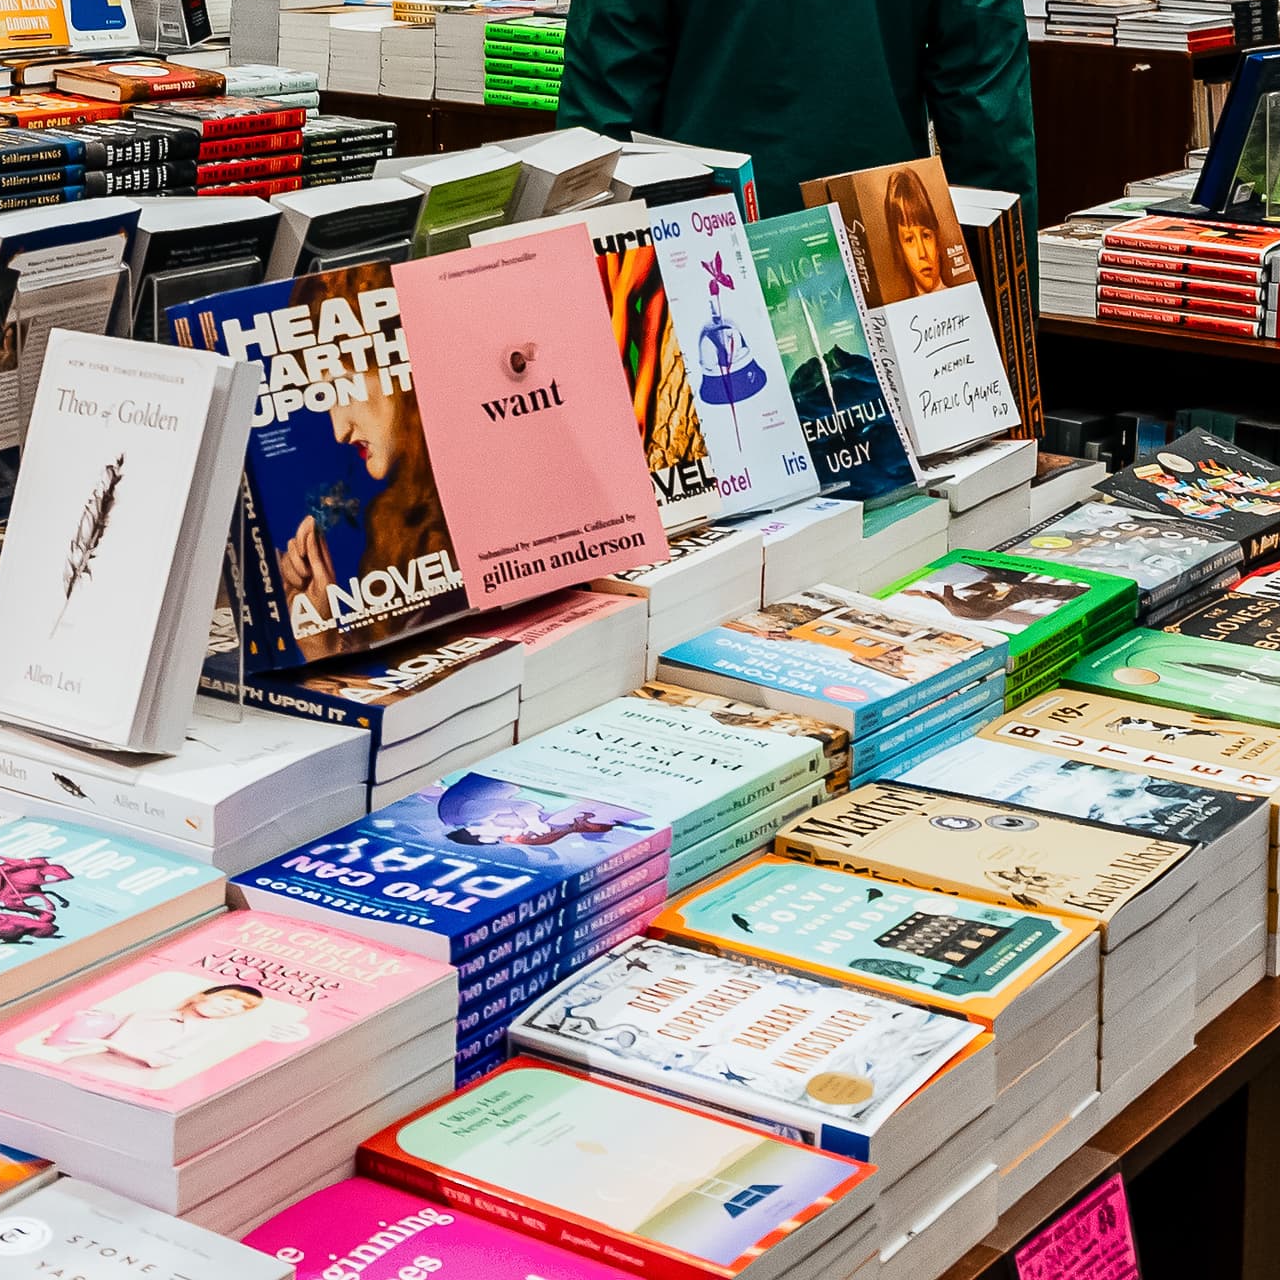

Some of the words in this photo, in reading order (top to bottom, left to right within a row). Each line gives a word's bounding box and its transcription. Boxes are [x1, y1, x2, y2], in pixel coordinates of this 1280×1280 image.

[690, 209, 737, 238] Ogawa
[220, 287, 400, 362] HEAP
[56, 386, 99, 418] Theo
[116, 395, 179, 434] Golden
[252, 373, 369, 429] UPON
[381, 364, 413, 399] IT
[481, 378, 564, 422] want
[781, 451, 808, 477] Iris
[482, 558, 547, 594] gillian
[550, 530, 646, 570] anderson
[288, 593, 321, 641] A
[320, 549, 462, 615] NOVEL
[1200, 600, 1280, 641] LIONESS
[23, 663, 54, 688] Allen
[56, 672, 83, 696] Levi
[819, 785, 938, 848] Martyr!
[464, 925, 489, 948] TWO
[492, 911, 516, 933] CAN
[518, 890, 557, 922] PLAY
[626, 976, 694, 1013] DEMON
[656, 976, 764, 1043] COPPERHEAD
[732, 1003, 813, 1051] BARBARA
[772, 1007, 875, 1074] KINGSOLVER
